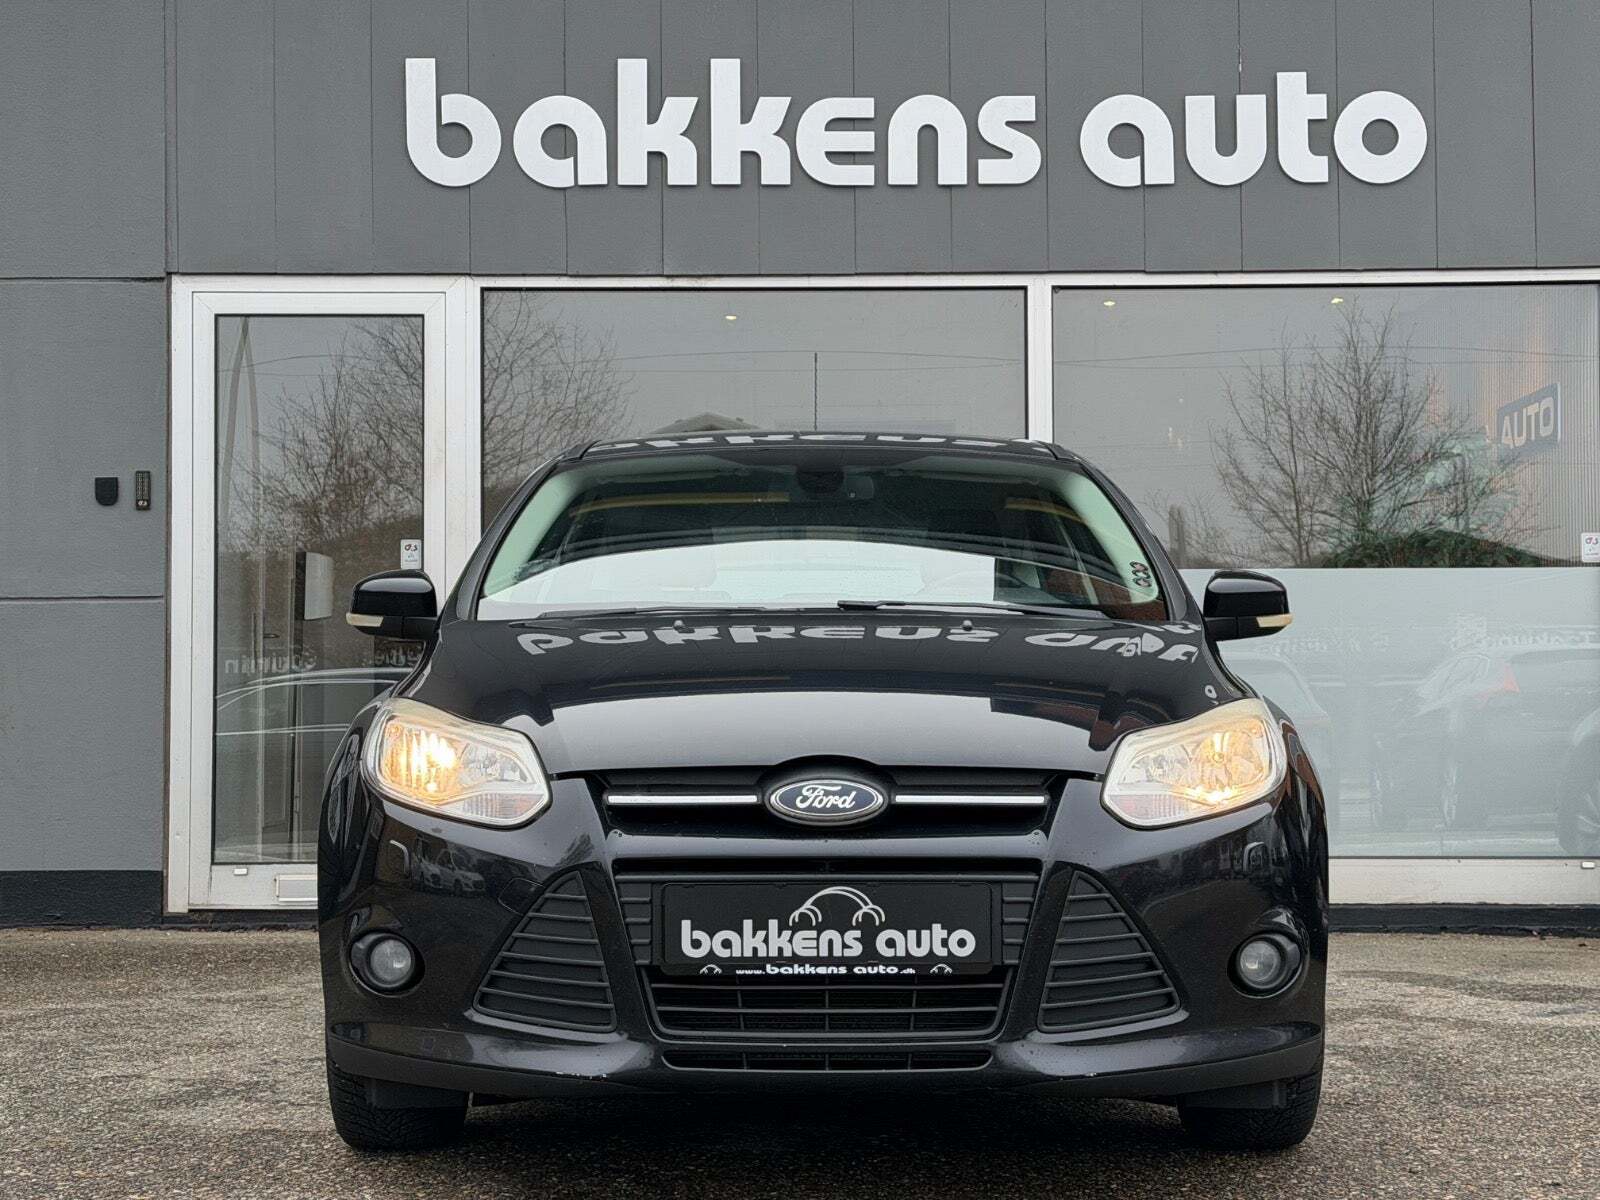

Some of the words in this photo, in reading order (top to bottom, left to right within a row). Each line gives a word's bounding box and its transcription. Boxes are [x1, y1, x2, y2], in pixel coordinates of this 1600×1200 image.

[405, 57, 1042, 188] bakkens
[1079, 71, 1428, 187] auto
[1501, 396, 1555, 450] AUTO
[795, 784, 857, 809] Ford
[681, 919, 863, 958] bakkens
[875, 923, 976, 958] auto
